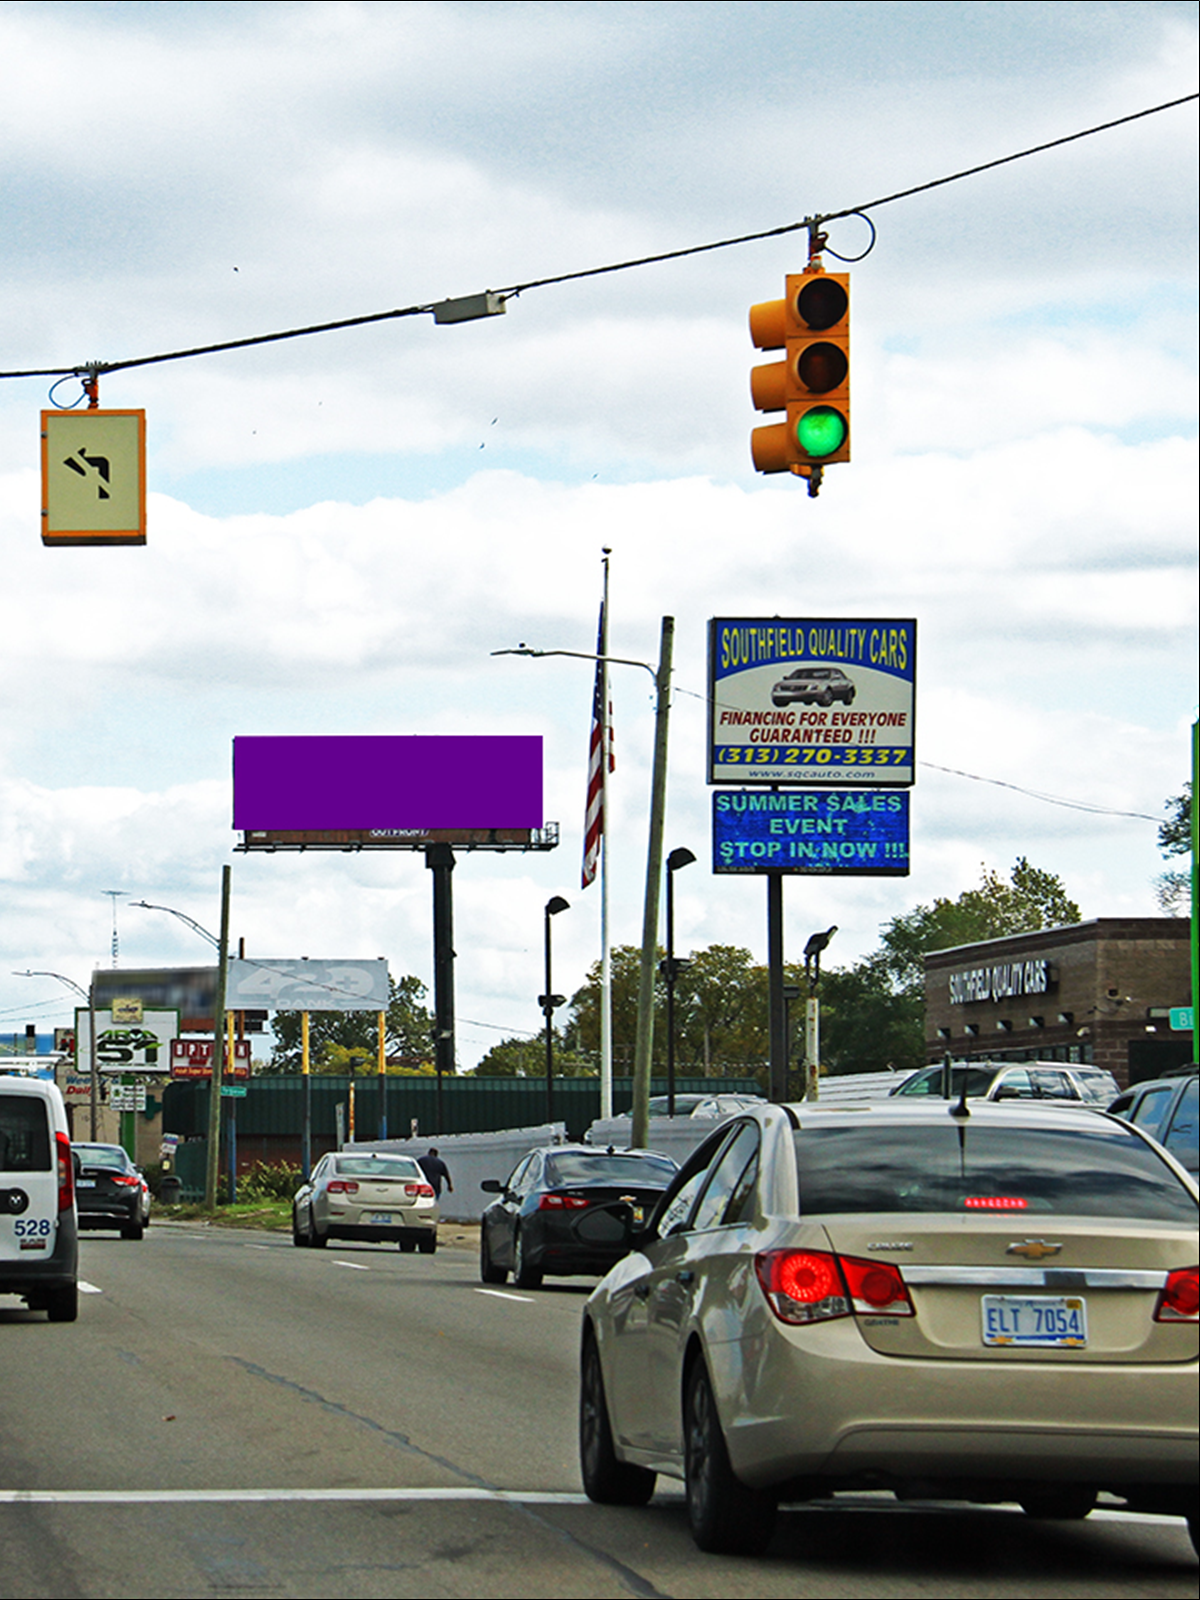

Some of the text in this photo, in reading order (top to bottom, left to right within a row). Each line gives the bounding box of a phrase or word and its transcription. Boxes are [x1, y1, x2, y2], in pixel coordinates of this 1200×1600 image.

[721, 628, 907, 670] SOUTHFIELD QUALITY CARS
[719, 711, 907, 727] FINANCING FOR EVERYONE
[749, 728, 876, 744] GUARANTEED !!!
[718, 747, 907, 764] (313) 270-3337
[748, 769, 875, 779] www.sqcauto.com
[716, 795, 902, 813] SUMMER SALES
[770, 818, 848, 834] EVENT
[719, 841, 781, 858] STOP
[790, 842, 814, 858] IN
[821, 842, 877, 858] NOW
[949, 959, 1047, 1004] SOUTHFIELD QUALITY CARS
[275, 999, 336, 1008] DANK
[97, 1029, 158, 1041] ARA
[14, 1219, 50, 1236] 528
[987, 1308, 1079, 1333] ELT 7054
